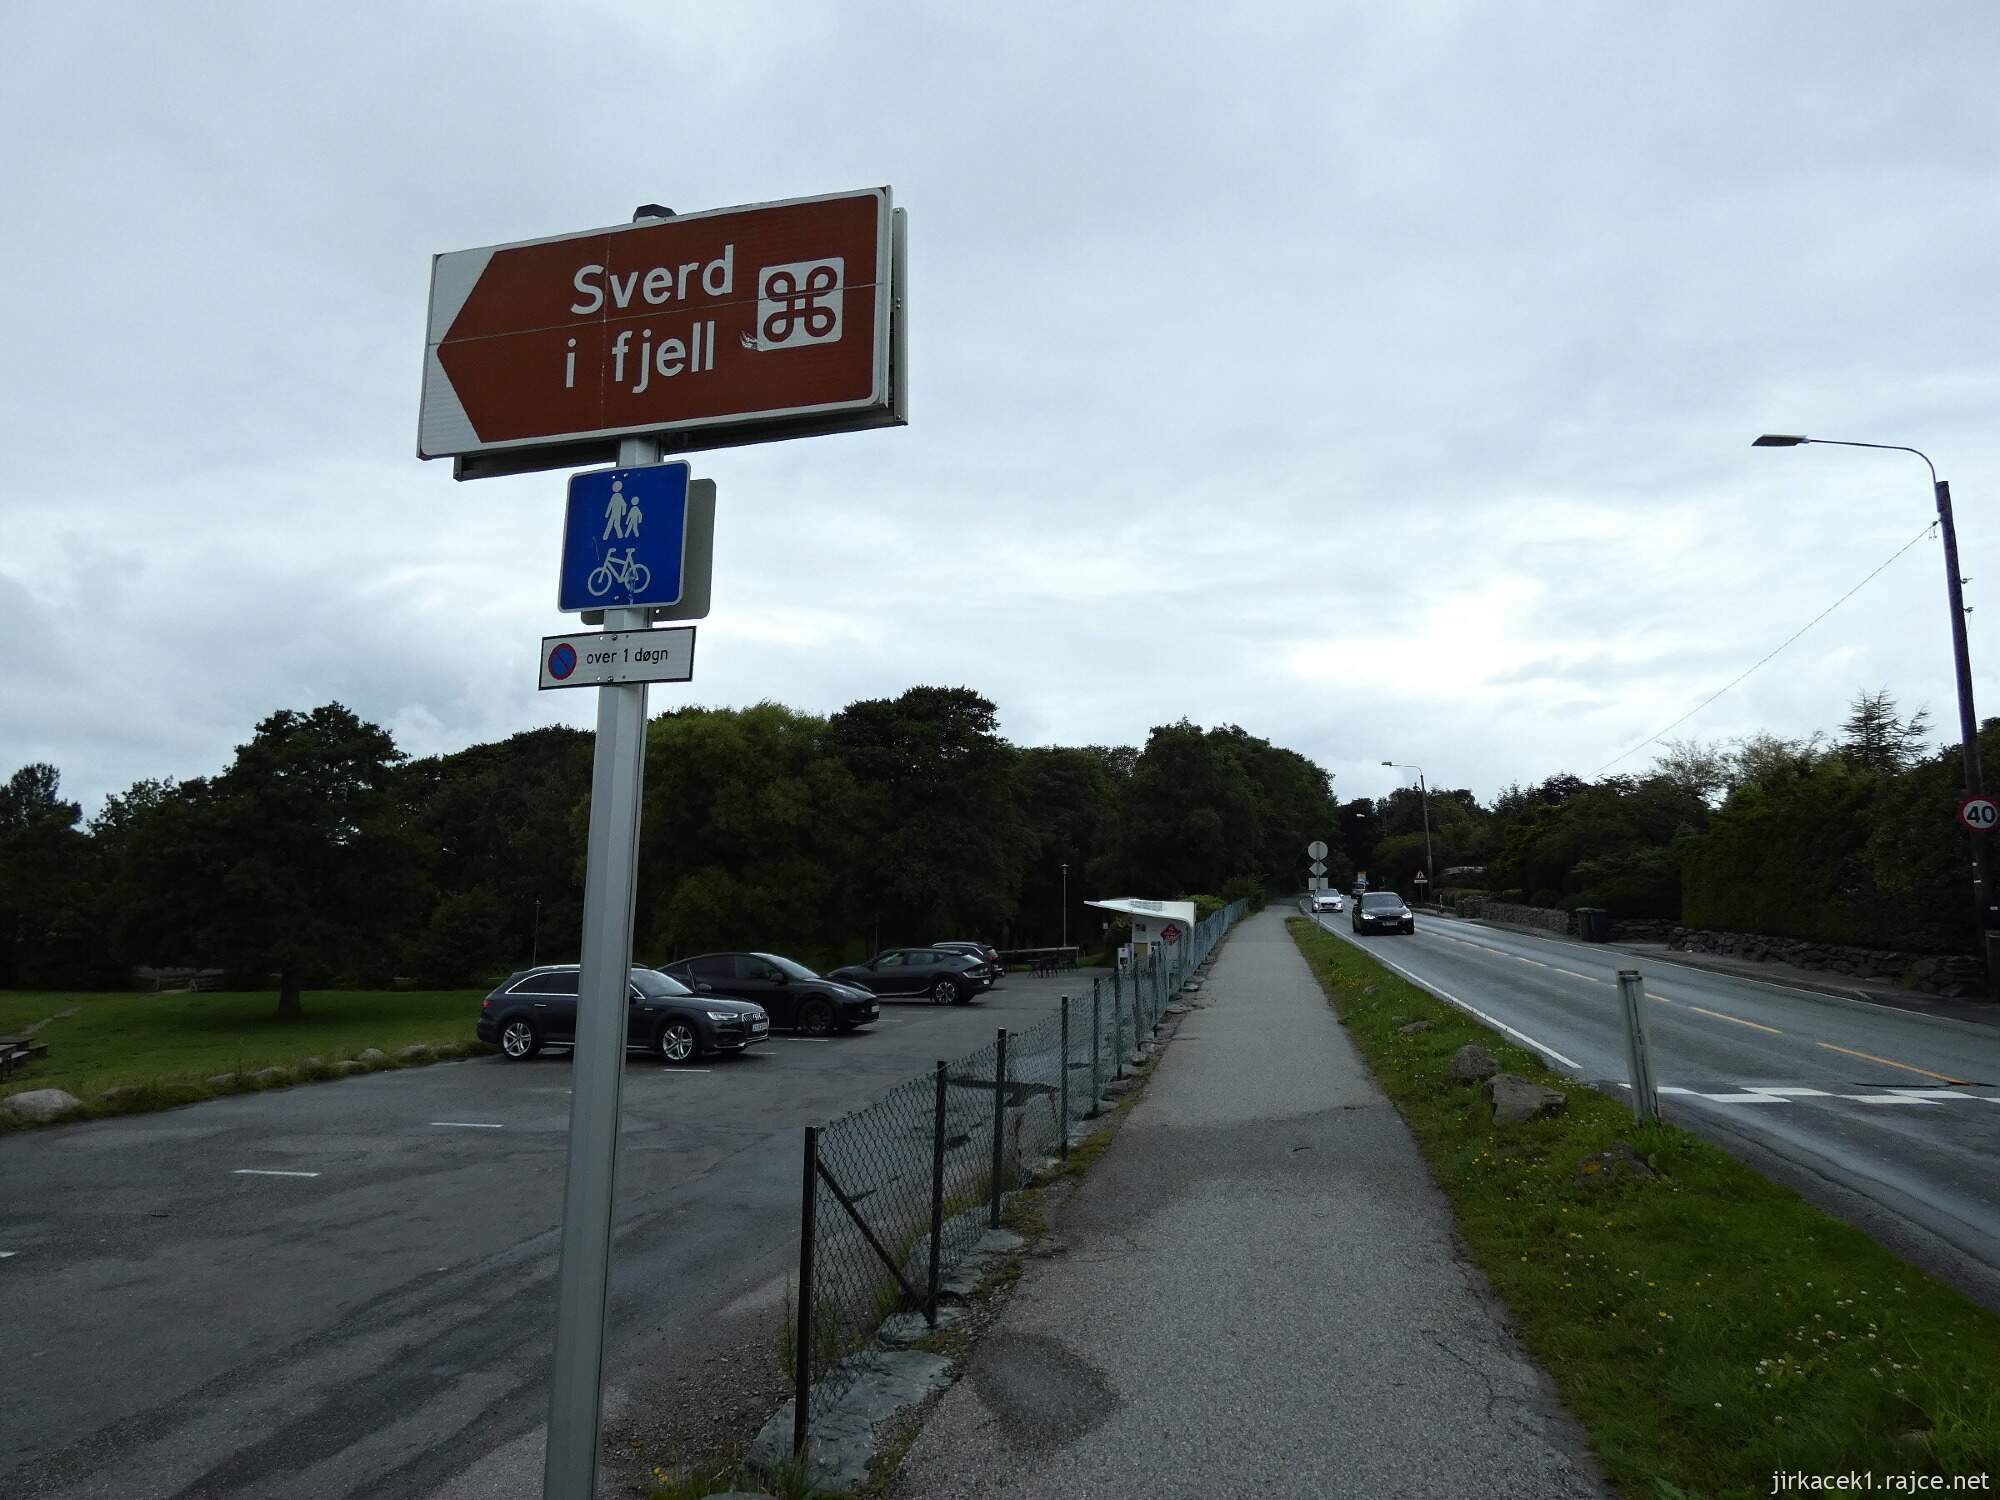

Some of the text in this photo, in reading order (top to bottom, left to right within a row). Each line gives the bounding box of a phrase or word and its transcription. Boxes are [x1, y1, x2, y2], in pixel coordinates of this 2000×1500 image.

[570, 244, 734, 315] Sverd
[565, 320, 715, 394] i fjell
[586, 648, 668, 665] over 1 døgn
[1967, 805, 1996, 823] 40
